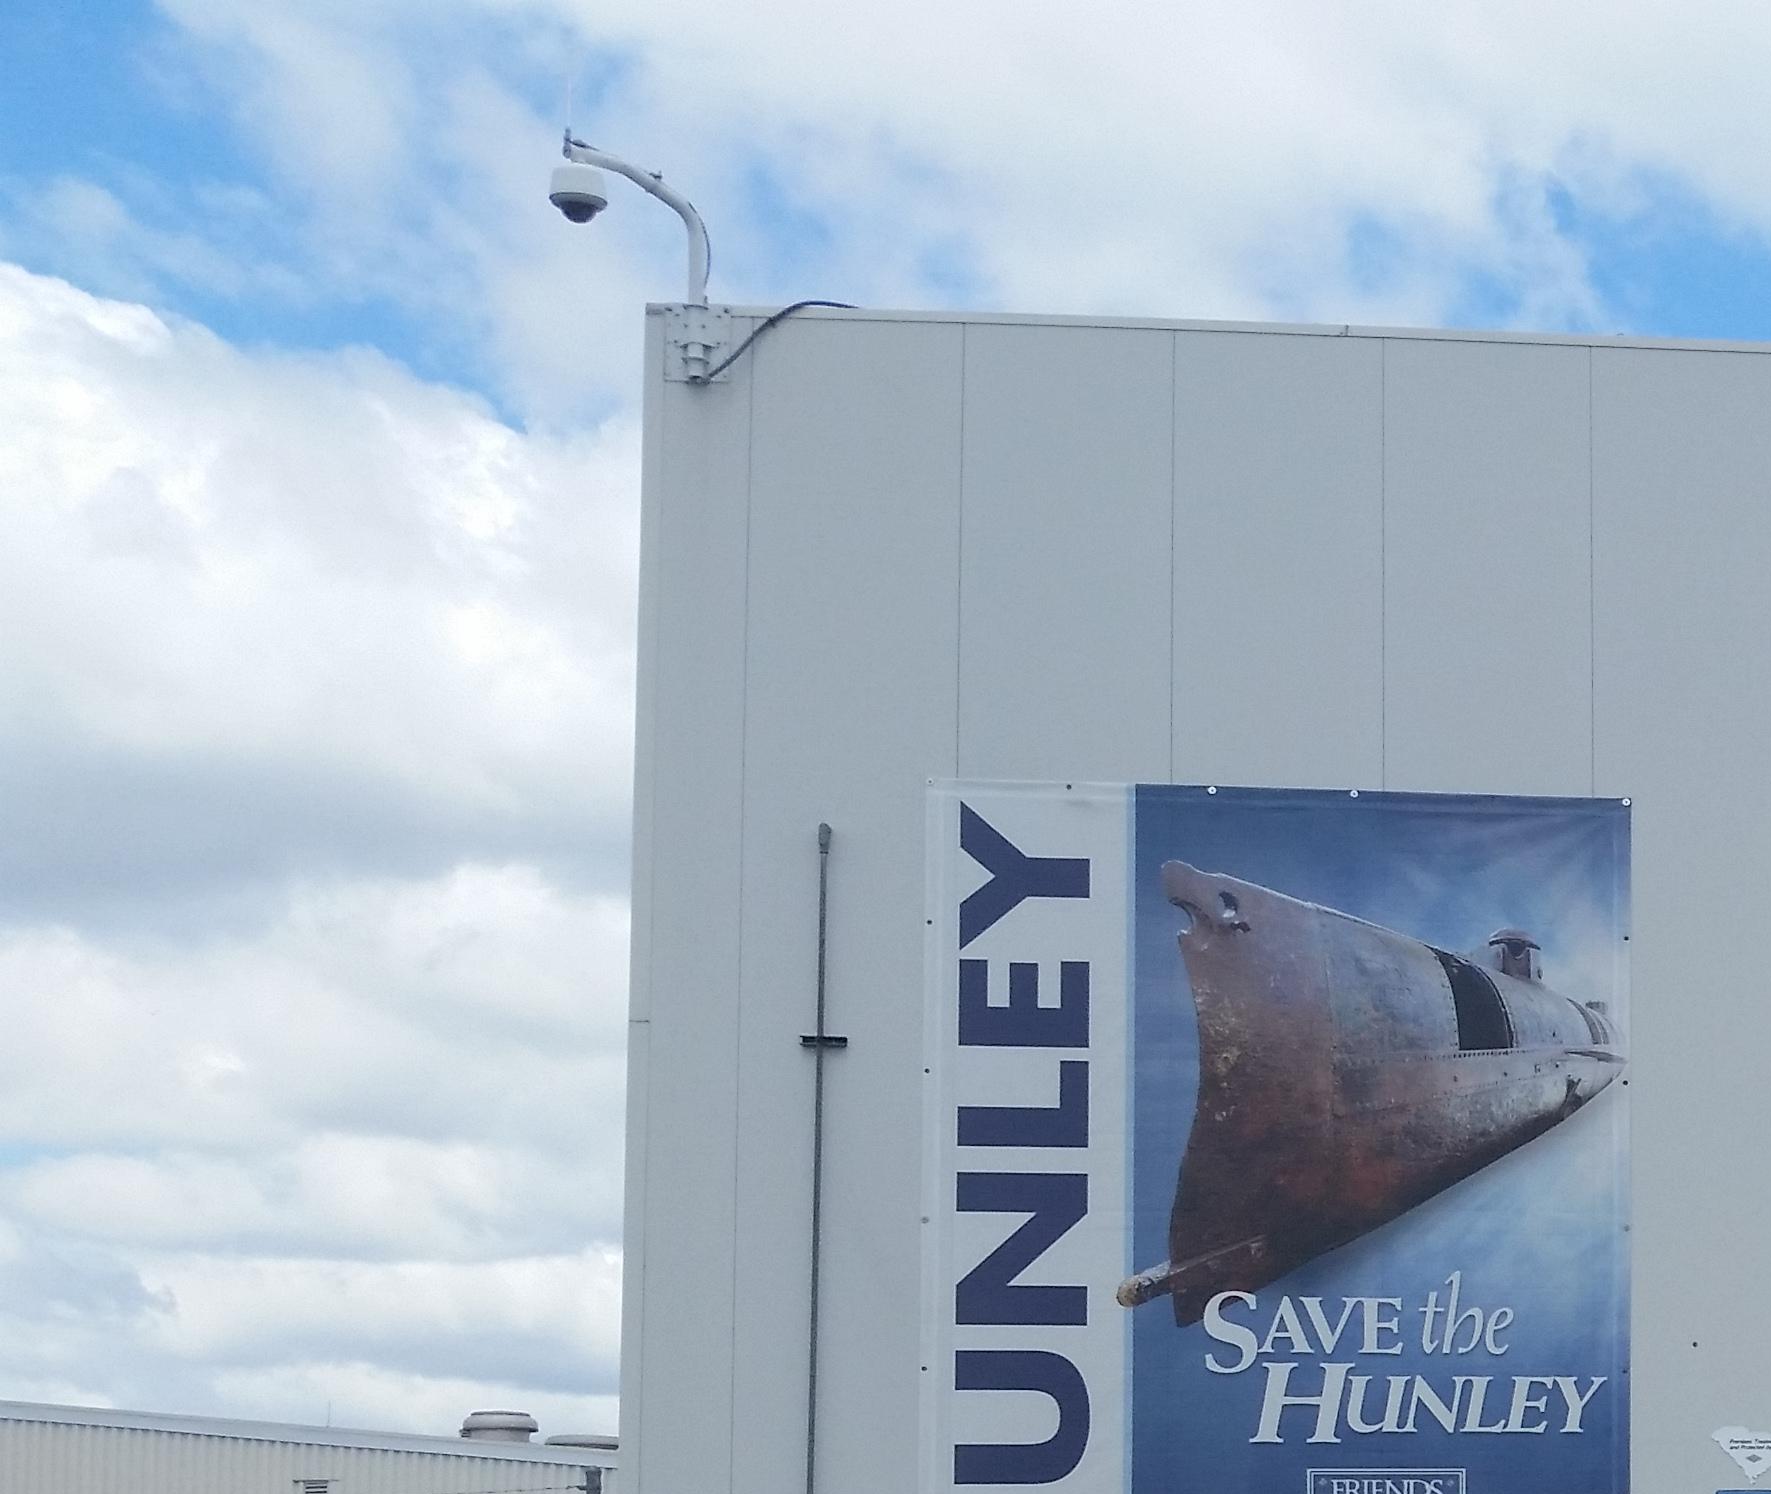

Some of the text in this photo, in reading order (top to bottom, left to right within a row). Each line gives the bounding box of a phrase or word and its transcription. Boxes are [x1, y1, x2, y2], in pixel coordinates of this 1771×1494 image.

[1203, 1270, 1515, 1375] SAVE the
[1249, 1361, 1608, 1444] HUNLEY
